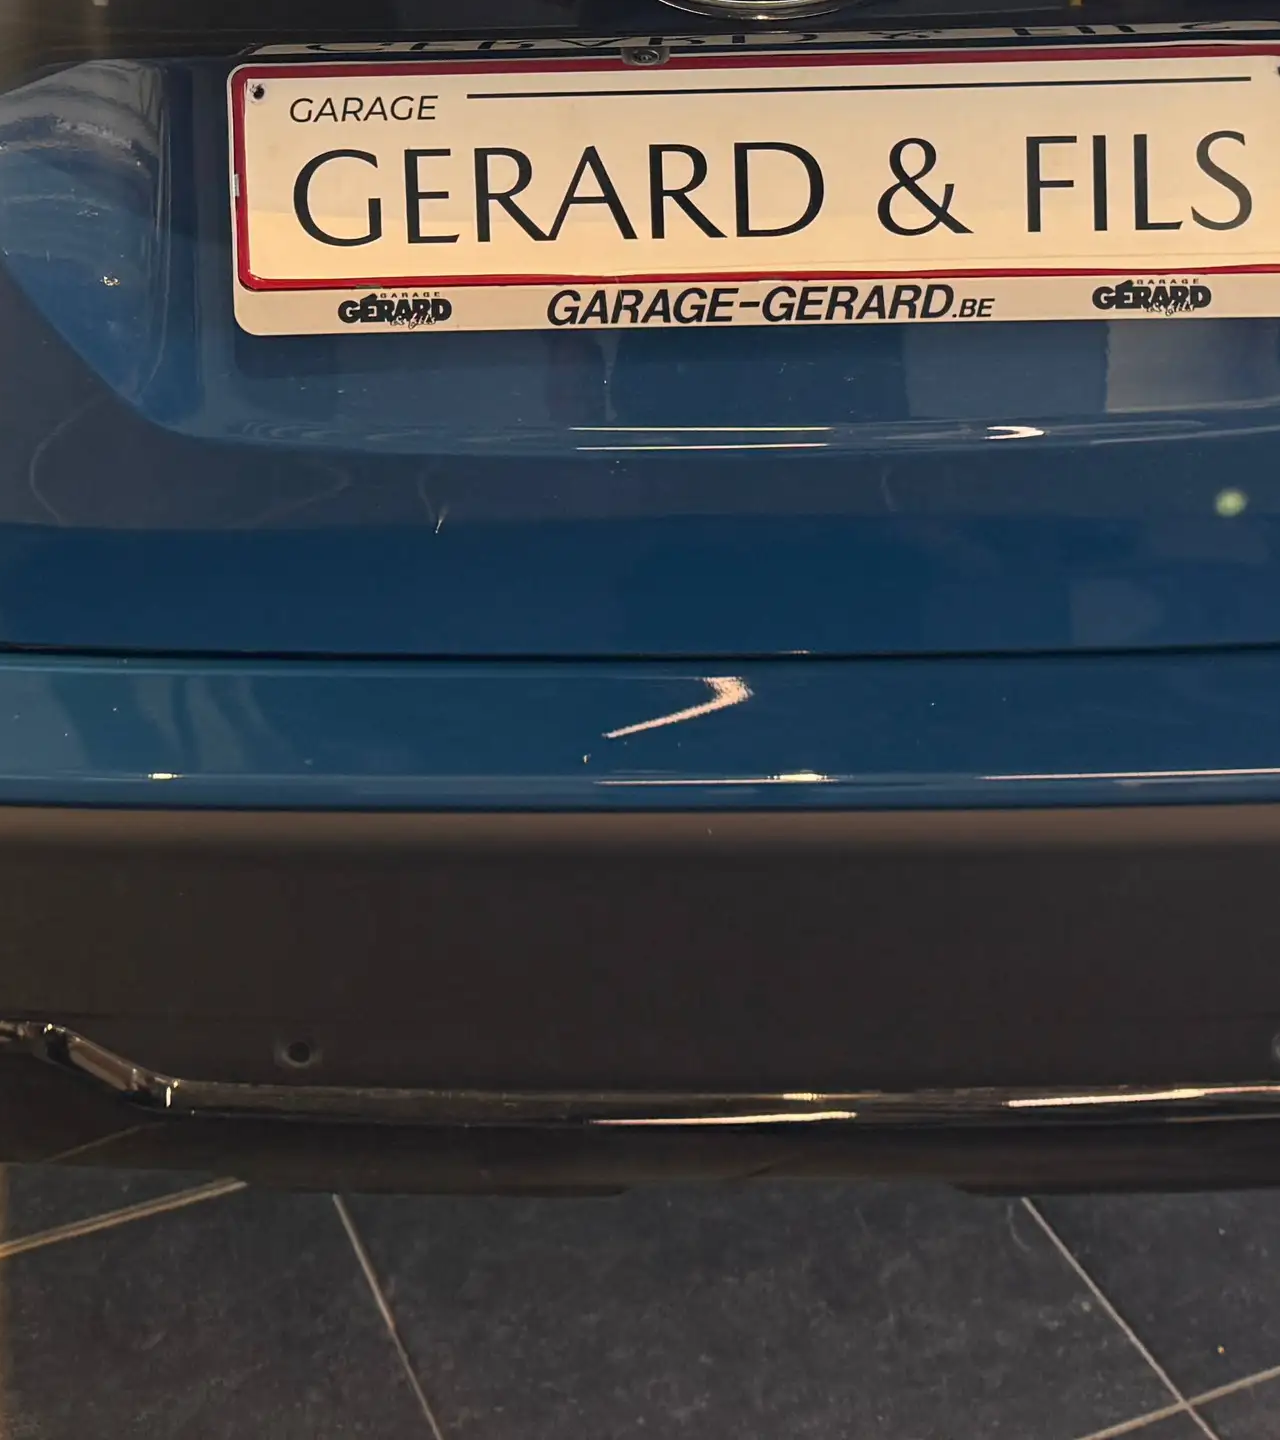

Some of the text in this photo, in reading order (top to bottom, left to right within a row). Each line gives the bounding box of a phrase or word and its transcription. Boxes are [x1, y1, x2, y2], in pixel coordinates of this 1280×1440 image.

[289, 95, 439, 123] GARAGE
[292, 129, 1253, 248] GERARD & FILS
[546, 283, 996, 326] GARAGE-GERARD.BE
